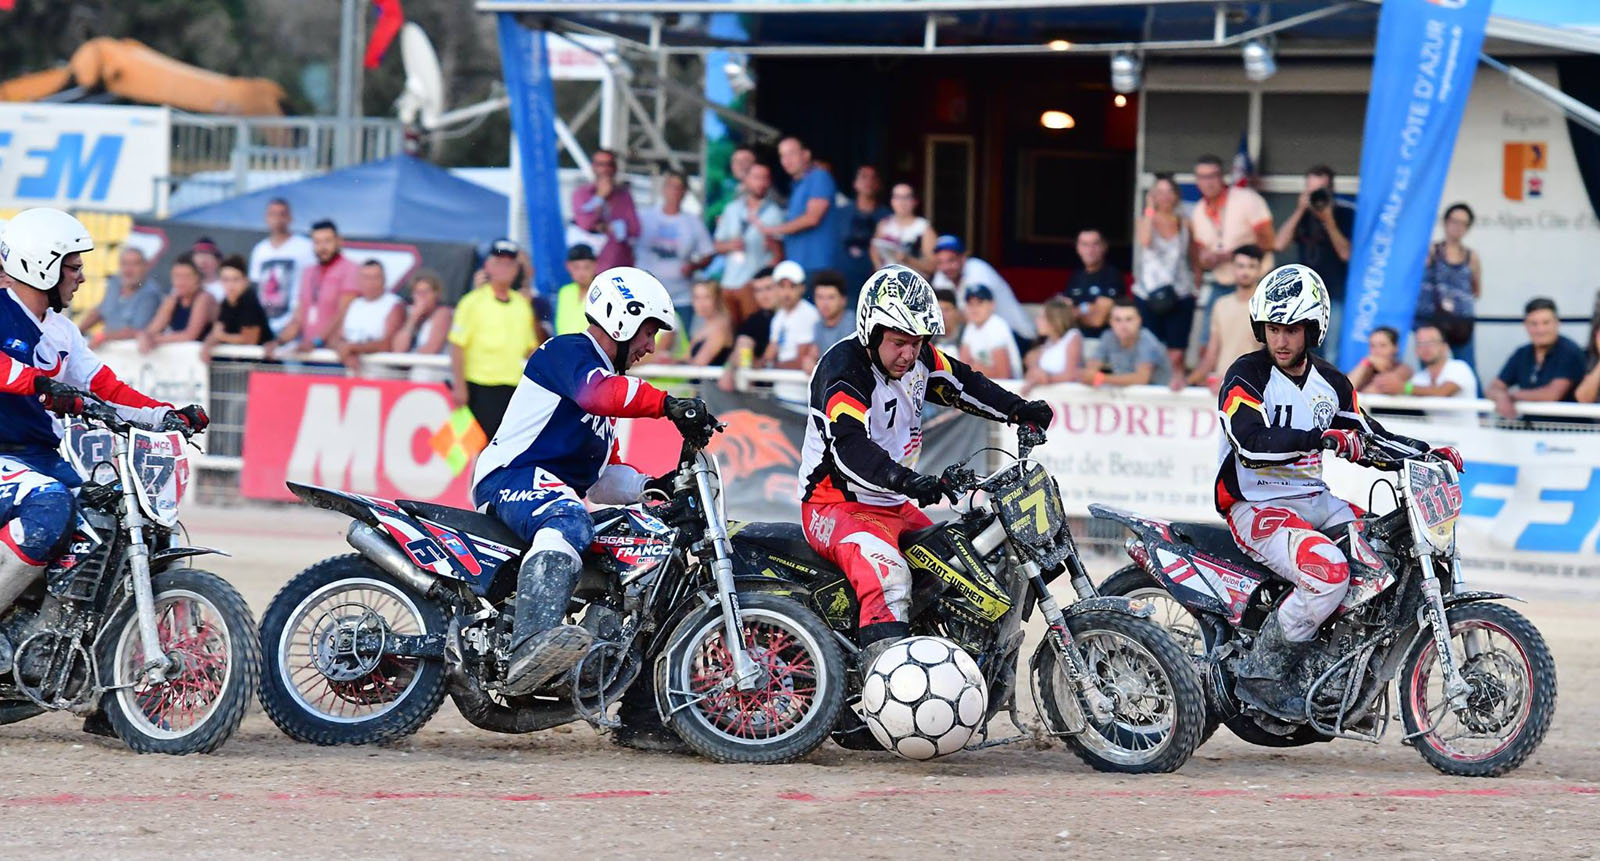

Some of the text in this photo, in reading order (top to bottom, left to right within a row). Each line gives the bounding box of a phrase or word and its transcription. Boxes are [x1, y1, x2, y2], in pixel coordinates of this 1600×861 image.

[45, 249, 63, 271] 7
[625, 300, 646, 317] 6
[884, 397, 898, 430] 7
[1272, 404, 1293, 429] 11
[135, 437, 171, 451] FRANCE
[1018, 487, 1051, 535] 7
[615, 545, 673, 559] FRANCE
